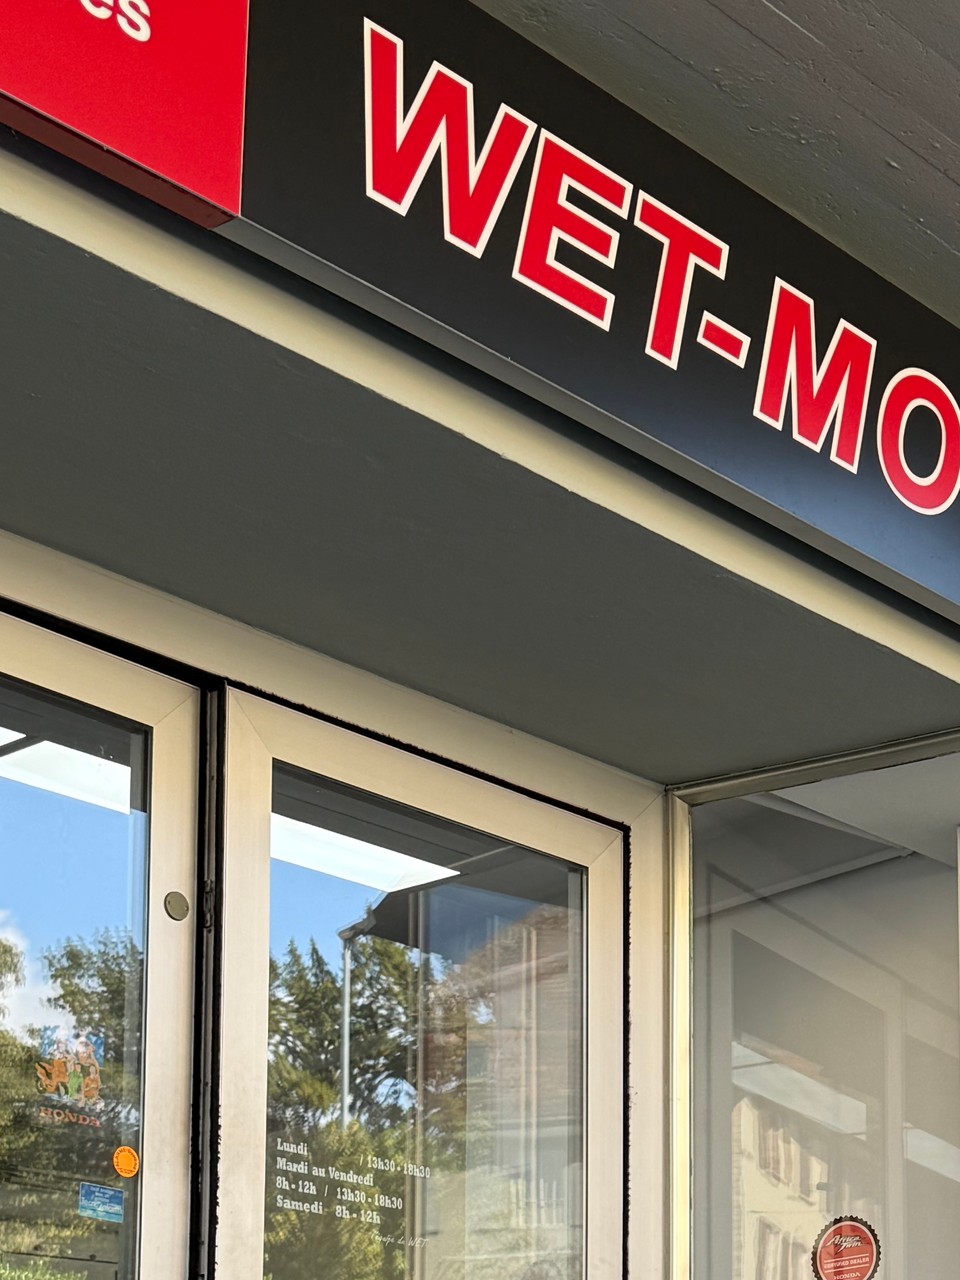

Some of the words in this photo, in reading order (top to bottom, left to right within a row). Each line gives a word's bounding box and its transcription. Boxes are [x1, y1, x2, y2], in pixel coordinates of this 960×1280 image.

[40, 1106, 102, 1128] HONDA
[276, 1138, 308, 1155] Lundi
[276, 1157, 308, 1174] Mardi
[312, 1166, 326, 1177] au
[328, 1167, 374, 1186] Vendredi
[276, 1194, 323, 1214] Samedi
[825, 1234, 861, 1247] Africa
[838, 1241, 862, 1252] Twin
[850, 1257, 870, 1266] DEALER
[833, 1271, 861, 1280] HONDA
